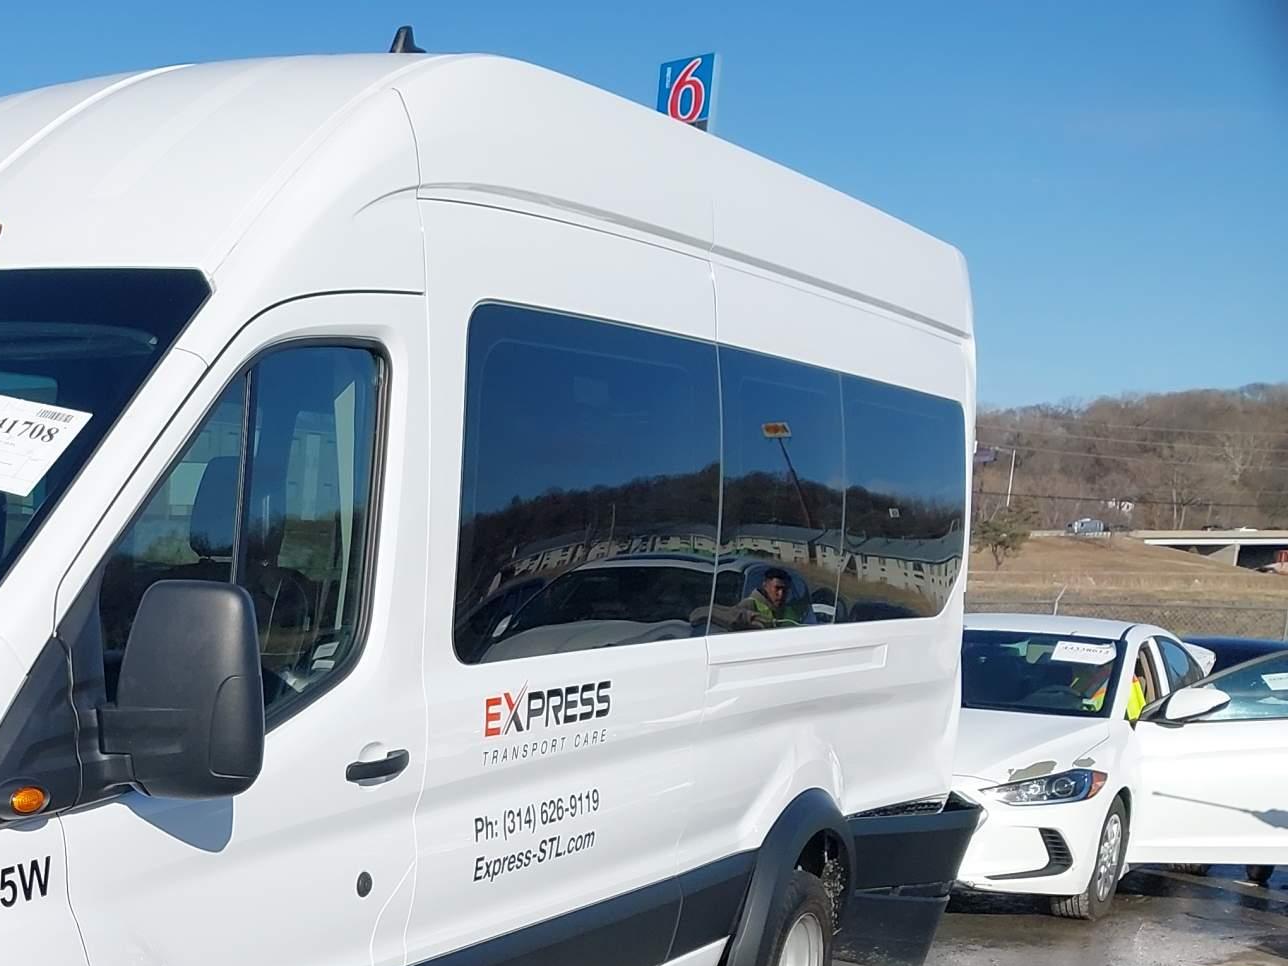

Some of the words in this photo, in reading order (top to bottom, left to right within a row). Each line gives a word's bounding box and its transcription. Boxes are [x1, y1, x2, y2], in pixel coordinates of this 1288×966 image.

[668, 57, 705, 123] 6
[485, 680, 611, 737] EXPRESS
[483, 736, 566, 766] TRANSPORT
[574, 729, 607, 748] CARE
[474, 817, 498, 842] Ph:
[503, 804, 536, 840] (314)
[540, 789, 600, 825] 626-9119
[473, 830, 595, 882] Express-STL.com
